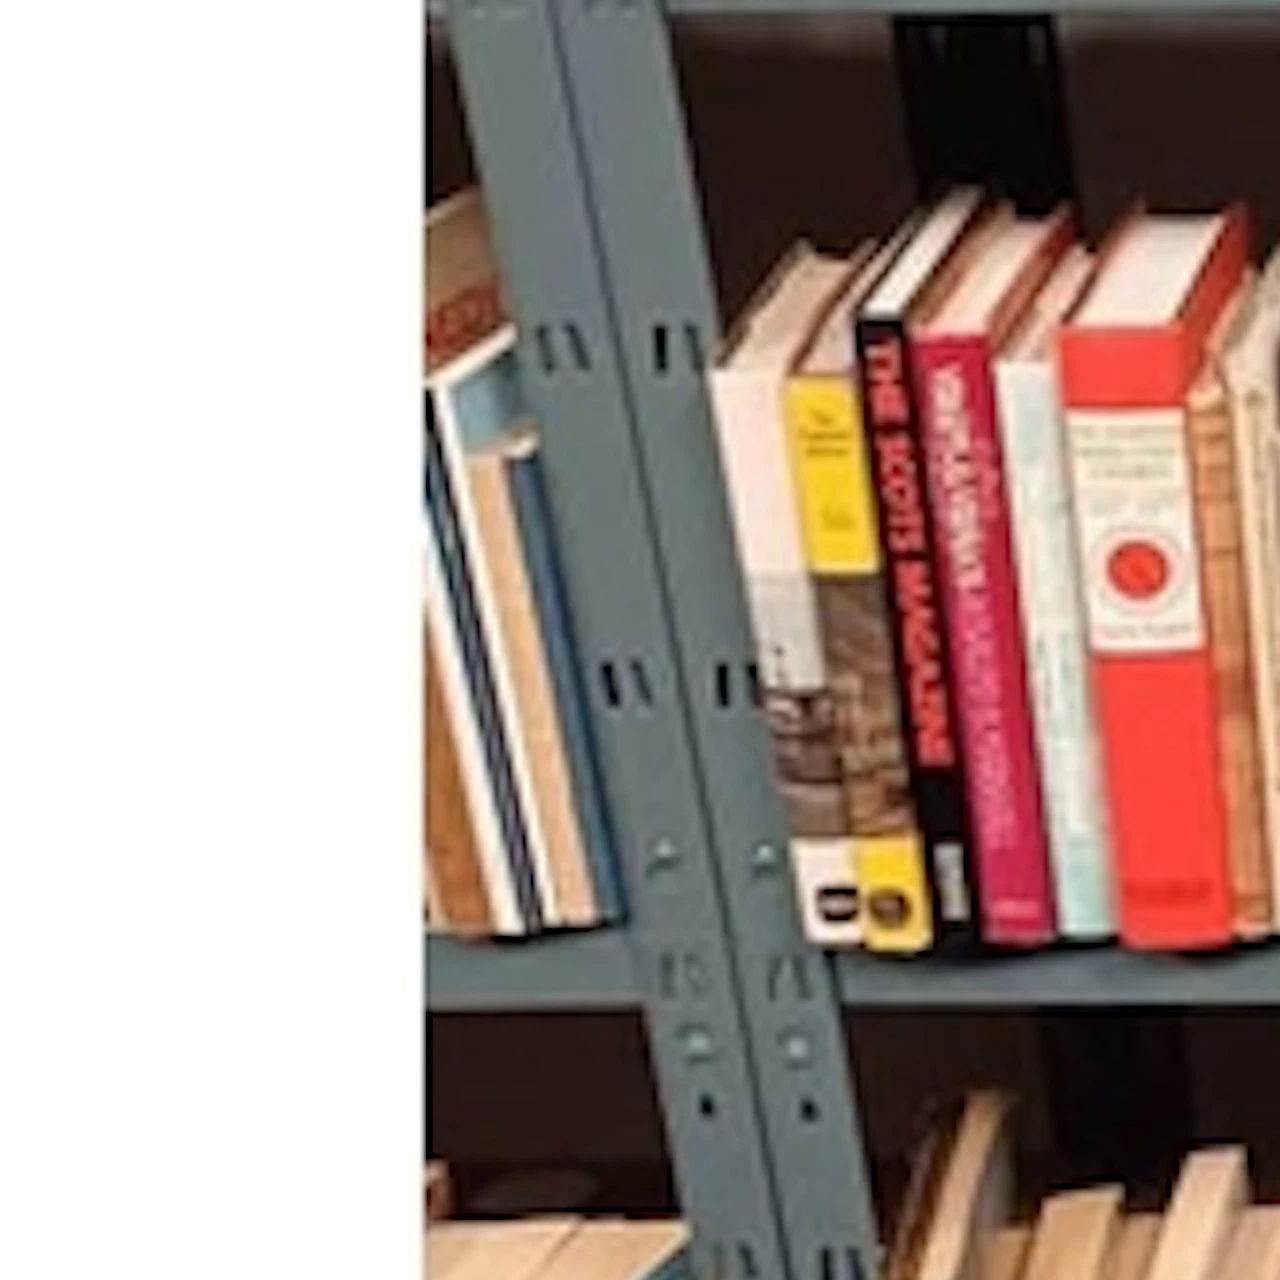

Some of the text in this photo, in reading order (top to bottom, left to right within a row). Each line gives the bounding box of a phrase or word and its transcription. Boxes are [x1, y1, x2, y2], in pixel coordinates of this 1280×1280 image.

[866, 340, 952, 770] THE SCOTS MAGAZINE
